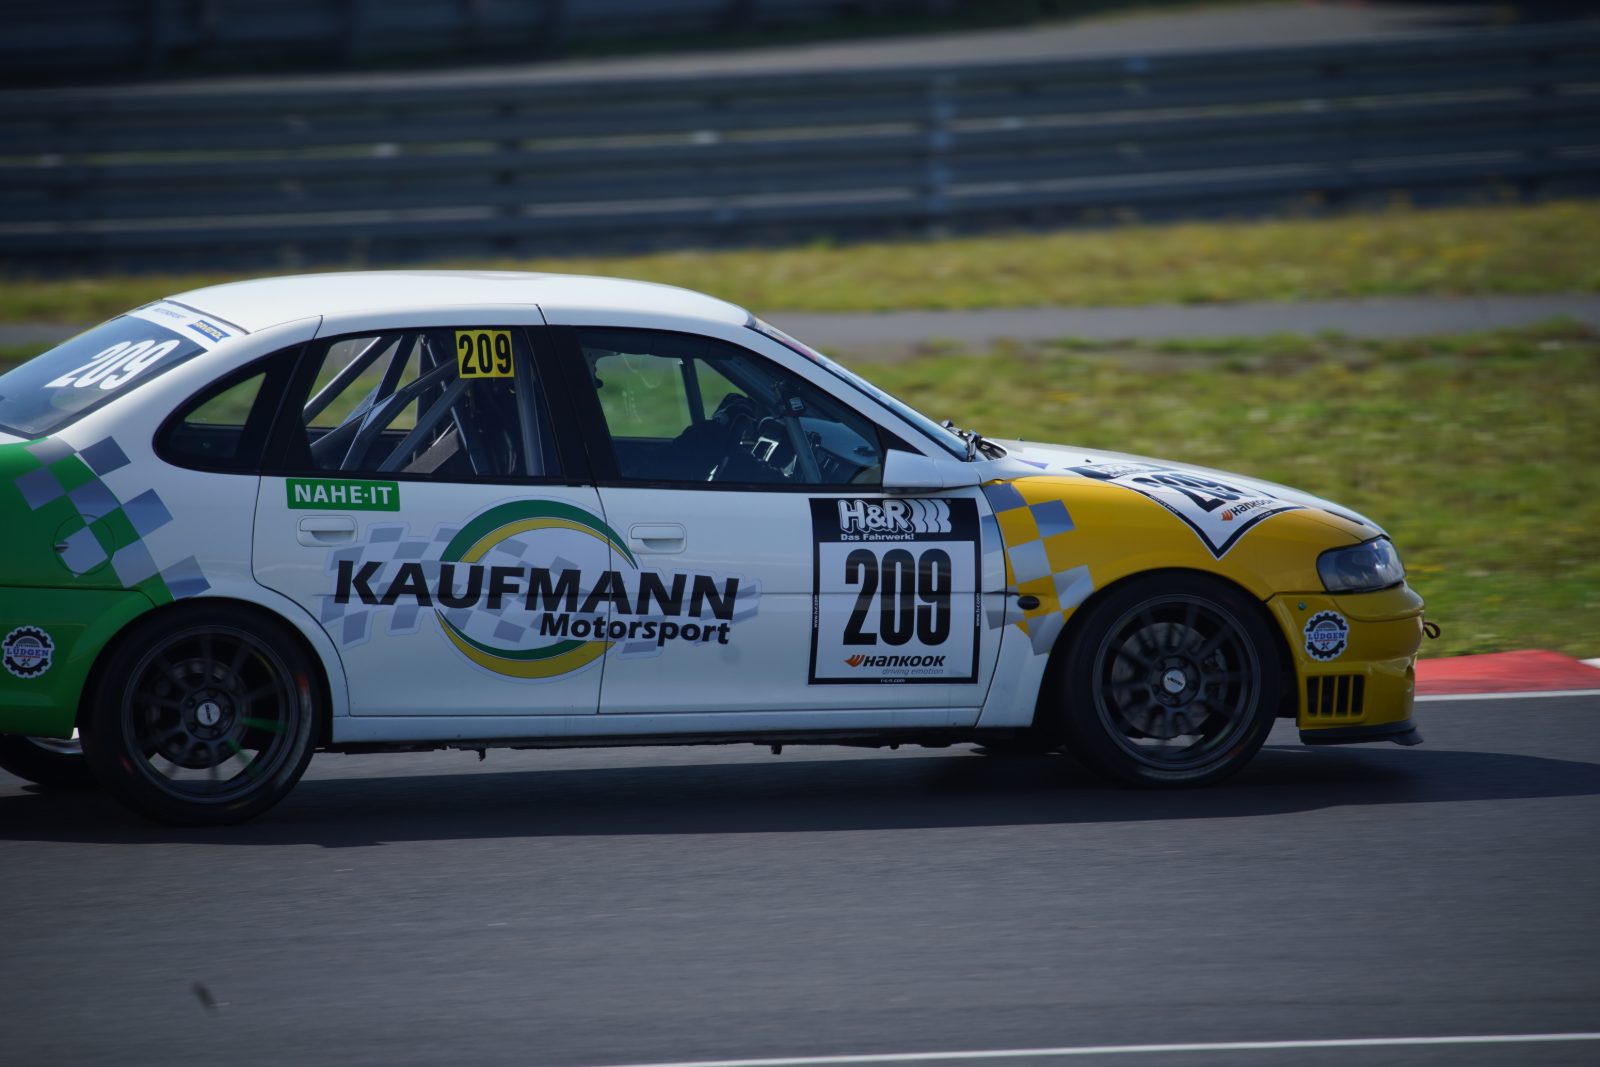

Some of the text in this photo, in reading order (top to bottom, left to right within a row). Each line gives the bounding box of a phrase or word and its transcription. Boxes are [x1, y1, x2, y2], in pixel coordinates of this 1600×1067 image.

[44, 339, 181, 390] 209
[458, 333, 512, 375] 209
[838, 499, 915, 533] H&R
[840, 533, 915, 541] Das Fahrwerk!
[334, 559, 740, 621] KAUFMANN
[843, 548, 951, 646] 209
[540, 612, 731, 645] Motorsport
[1307, 631, 1345, 641] LÜDGEN
[6, 647, 49, 657] LÜDGEN
[882, 668, 910, 676] driving
